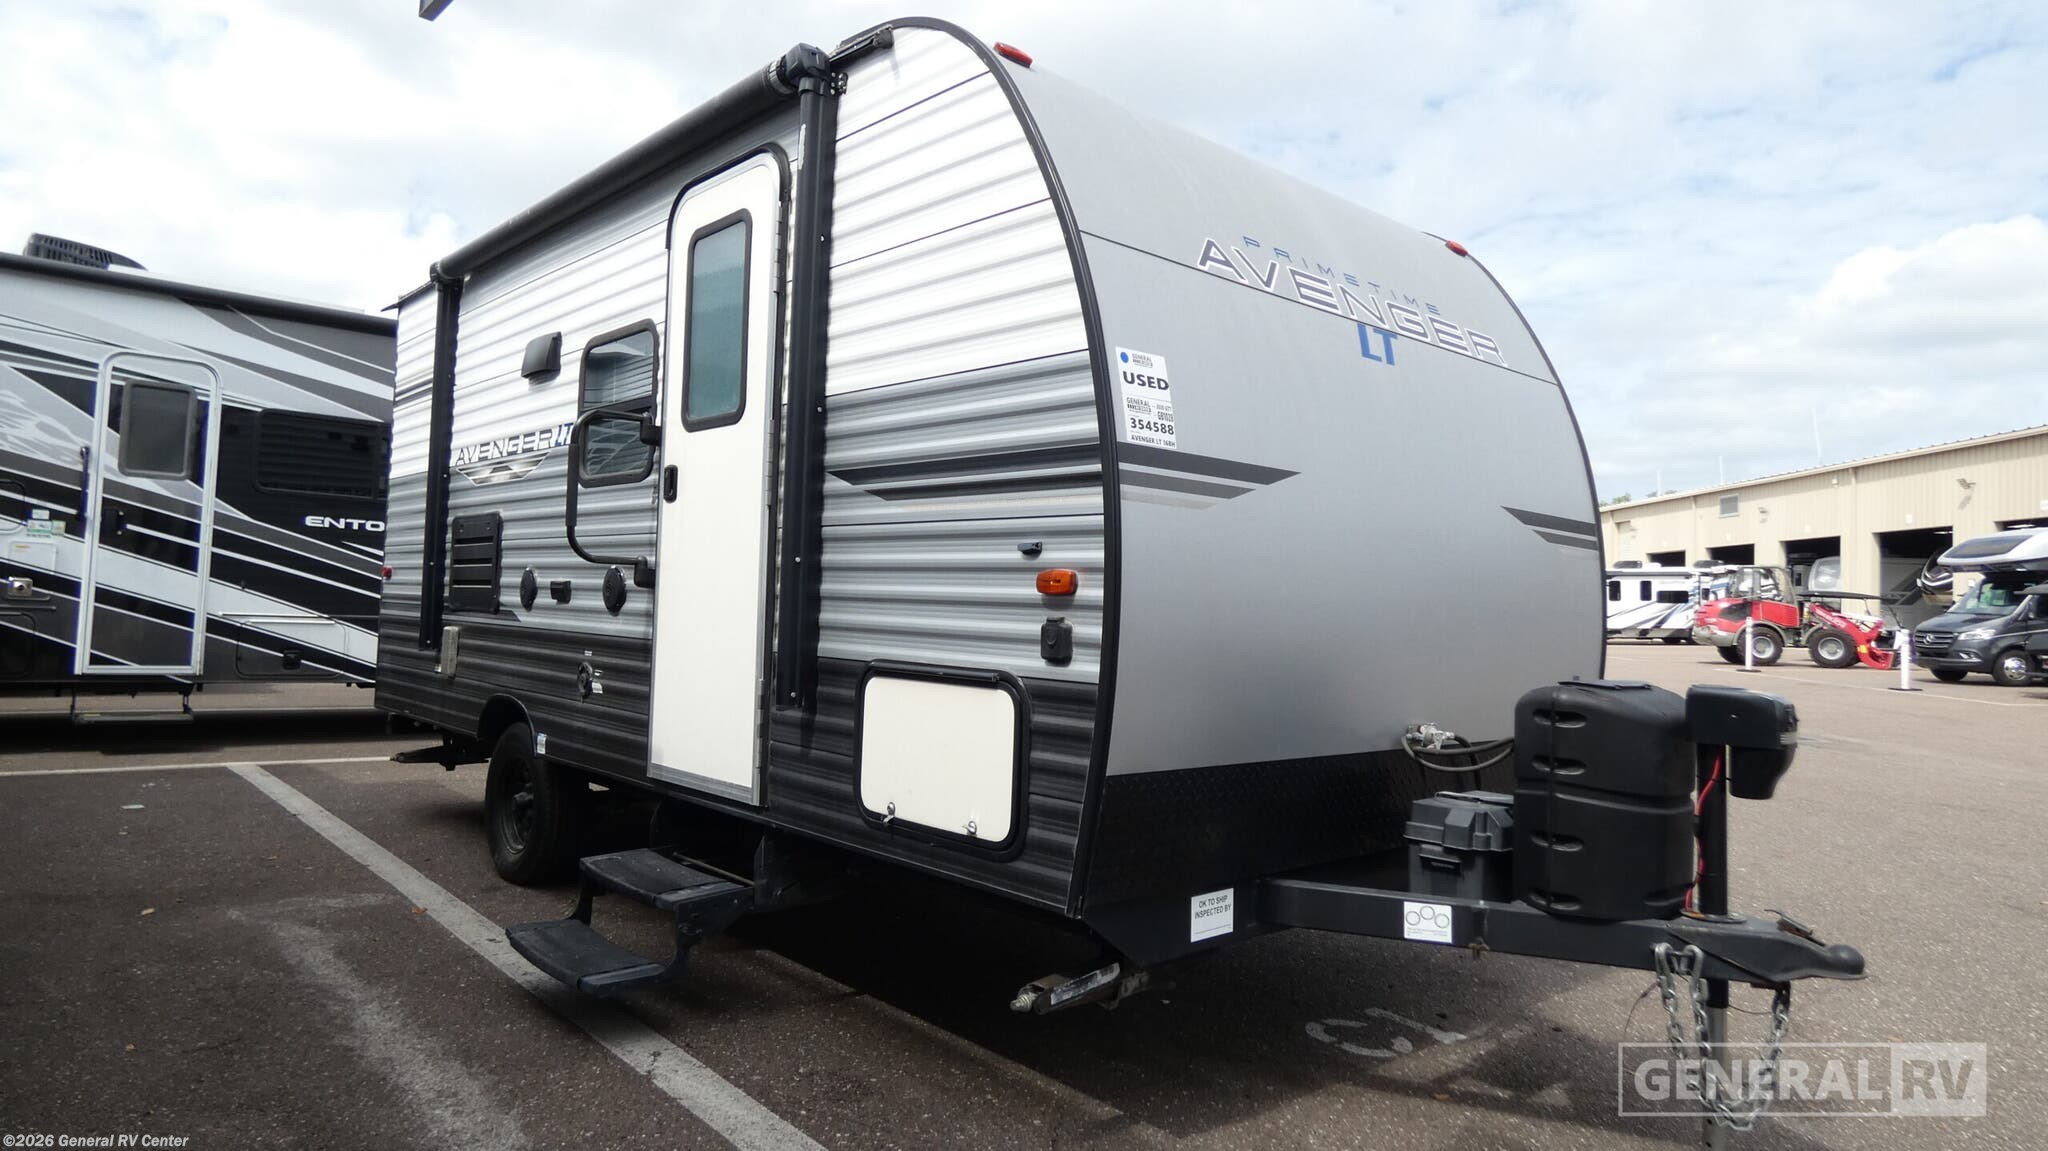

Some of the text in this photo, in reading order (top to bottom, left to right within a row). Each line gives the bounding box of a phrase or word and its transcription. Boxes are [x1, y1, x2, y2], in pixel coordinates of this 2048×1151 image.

[1197, 238, 1507, 367] AVENGER
[1357, 321, 1398, 366] LT
[1122, 371, 1169, 391] USED
[1129, 417, 1174, 435] 354588
[453, 422, 574, 467] AVENGER LT
[1131, 434, 1155, 444] AVENGER
[304, 515, 386, 532] ENTO
[1198, 894, 1228, 908] OK TO SHIP
[1194, 903, 1232, 919] INSPECTED BY
